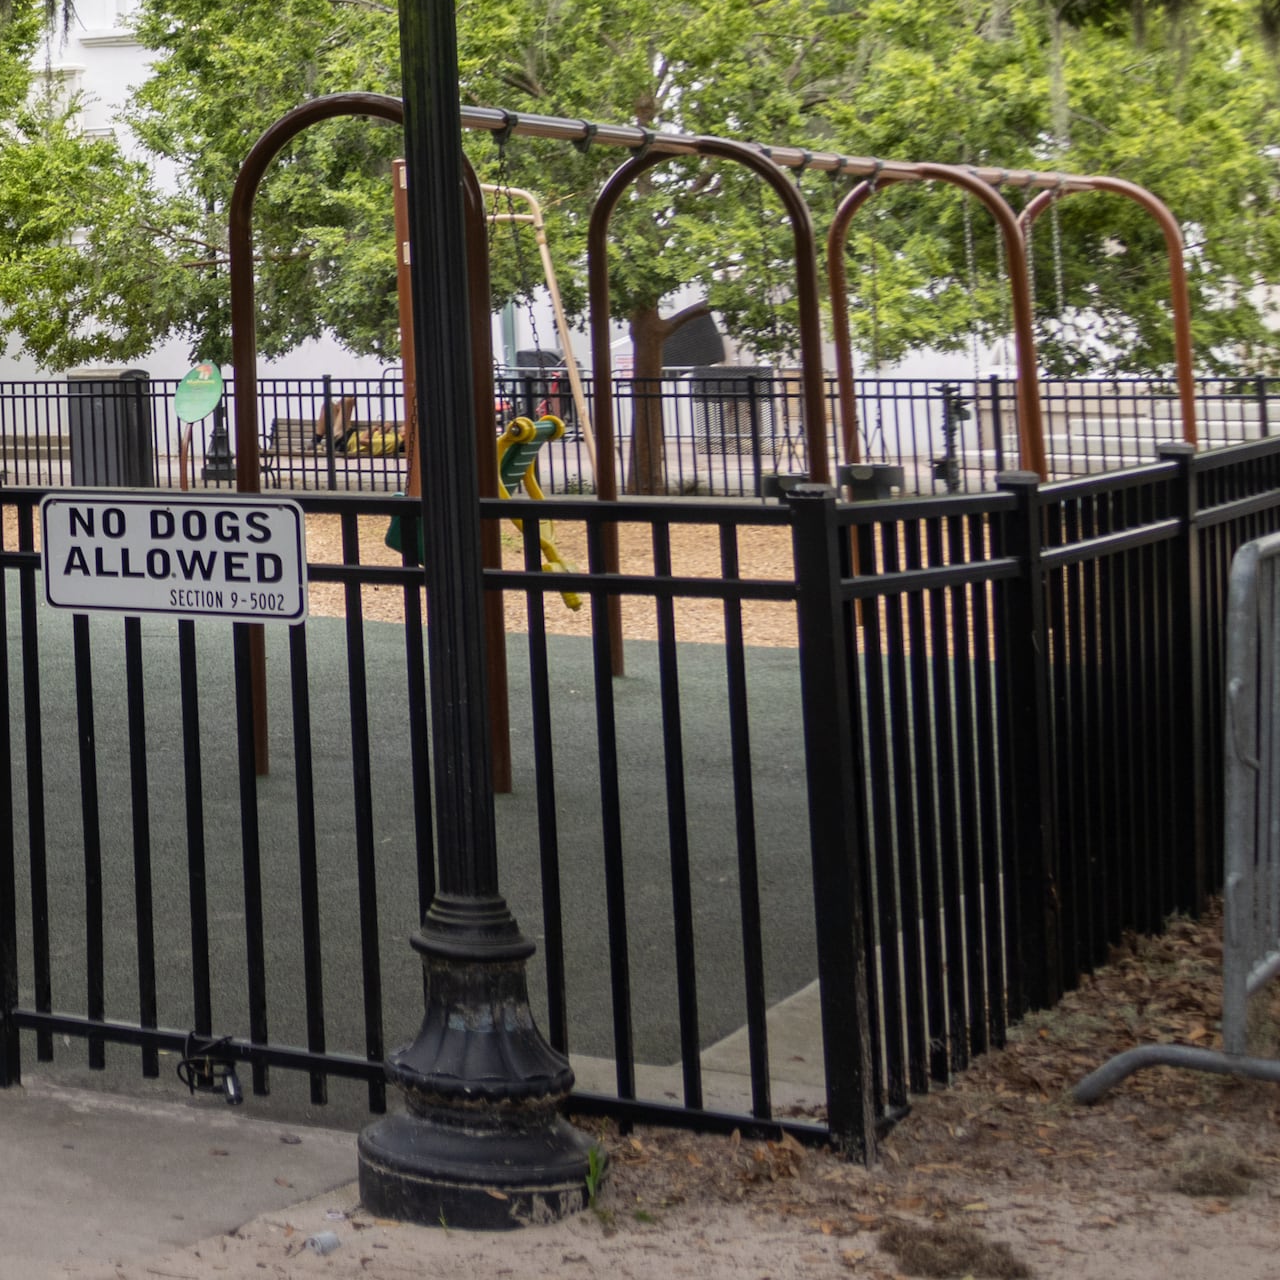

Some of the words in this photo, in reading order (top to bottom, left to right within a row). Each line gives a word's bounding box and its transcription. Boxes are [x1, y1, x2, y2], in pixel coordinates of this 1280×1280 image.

[69, 507, 126, 539] NO
[150, 509, 272, 543] DOGS
[63, 546, 283, 583] ALLOWED
[170, 589, 223, 609] SECTION
[230, 593, 285, 611] 9-5002
